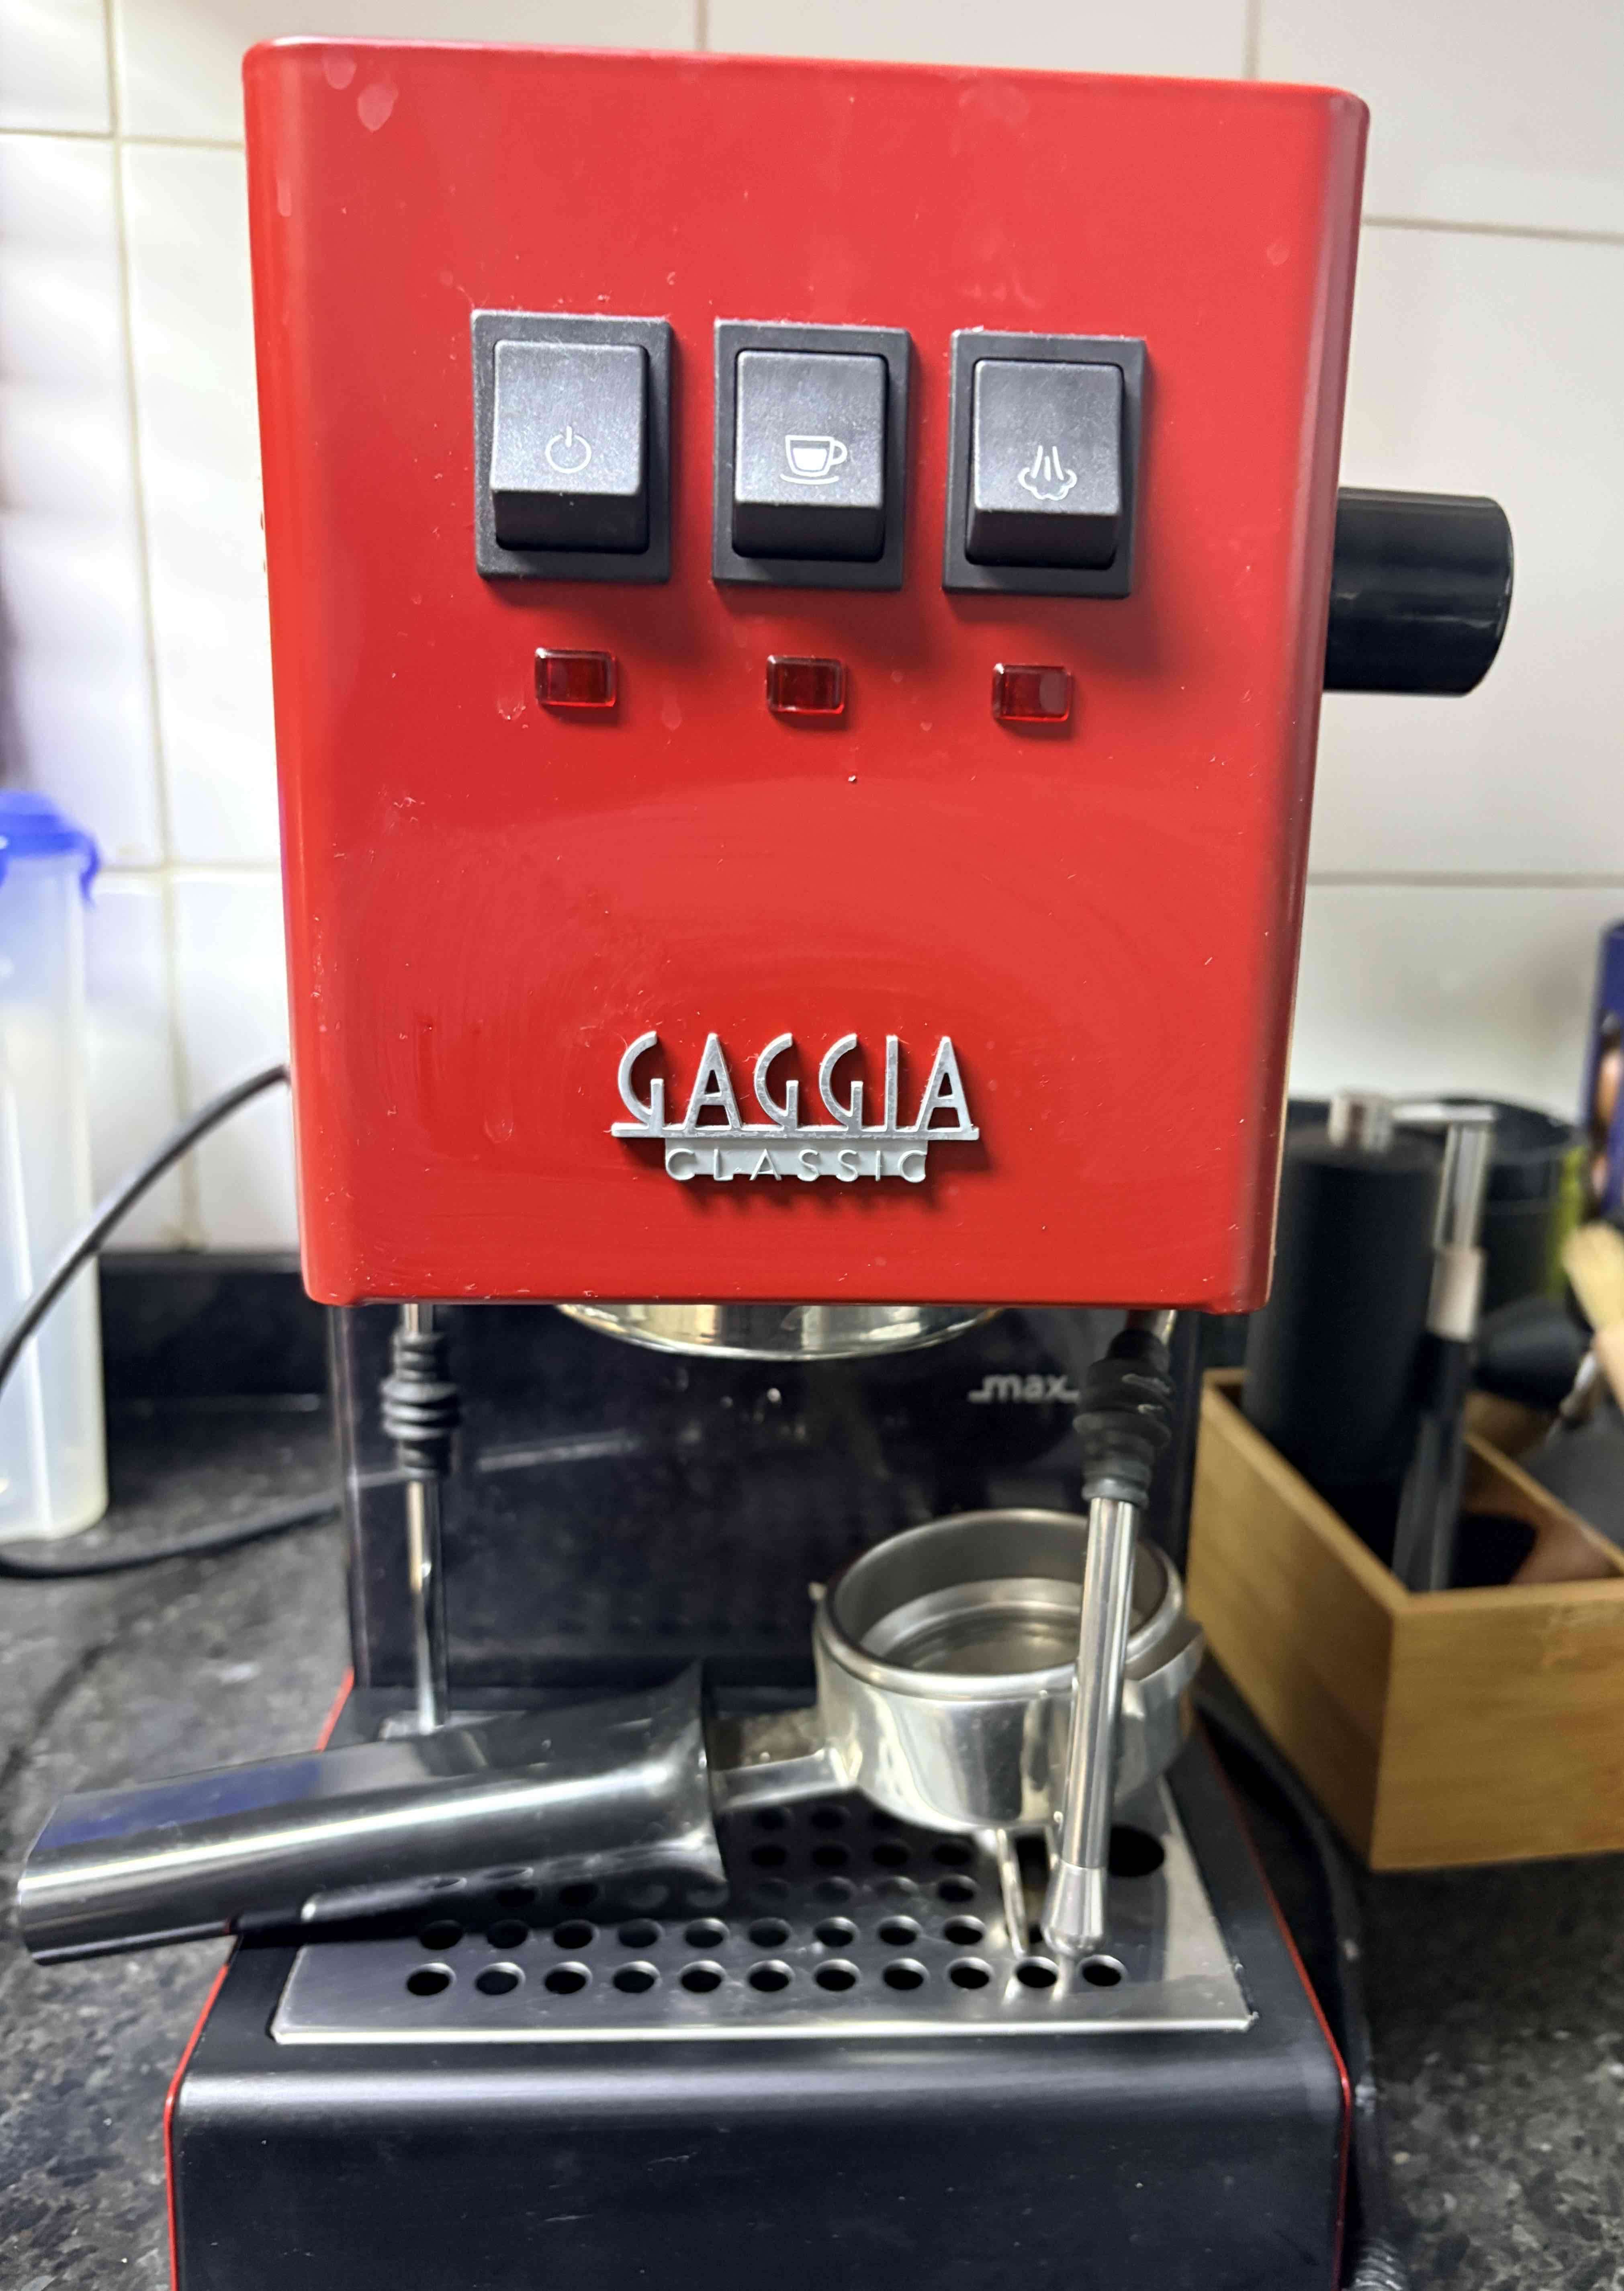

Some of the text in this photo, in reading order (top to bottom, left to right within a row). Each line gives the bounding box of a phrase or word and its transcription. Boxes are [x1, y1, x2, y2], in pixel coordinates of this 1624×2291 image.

[616, 1030, 976, 1136] GAGGIA
[665, 1148, 927, 1183] CLASSIC
[981, 1374, 1069, 1403] max
